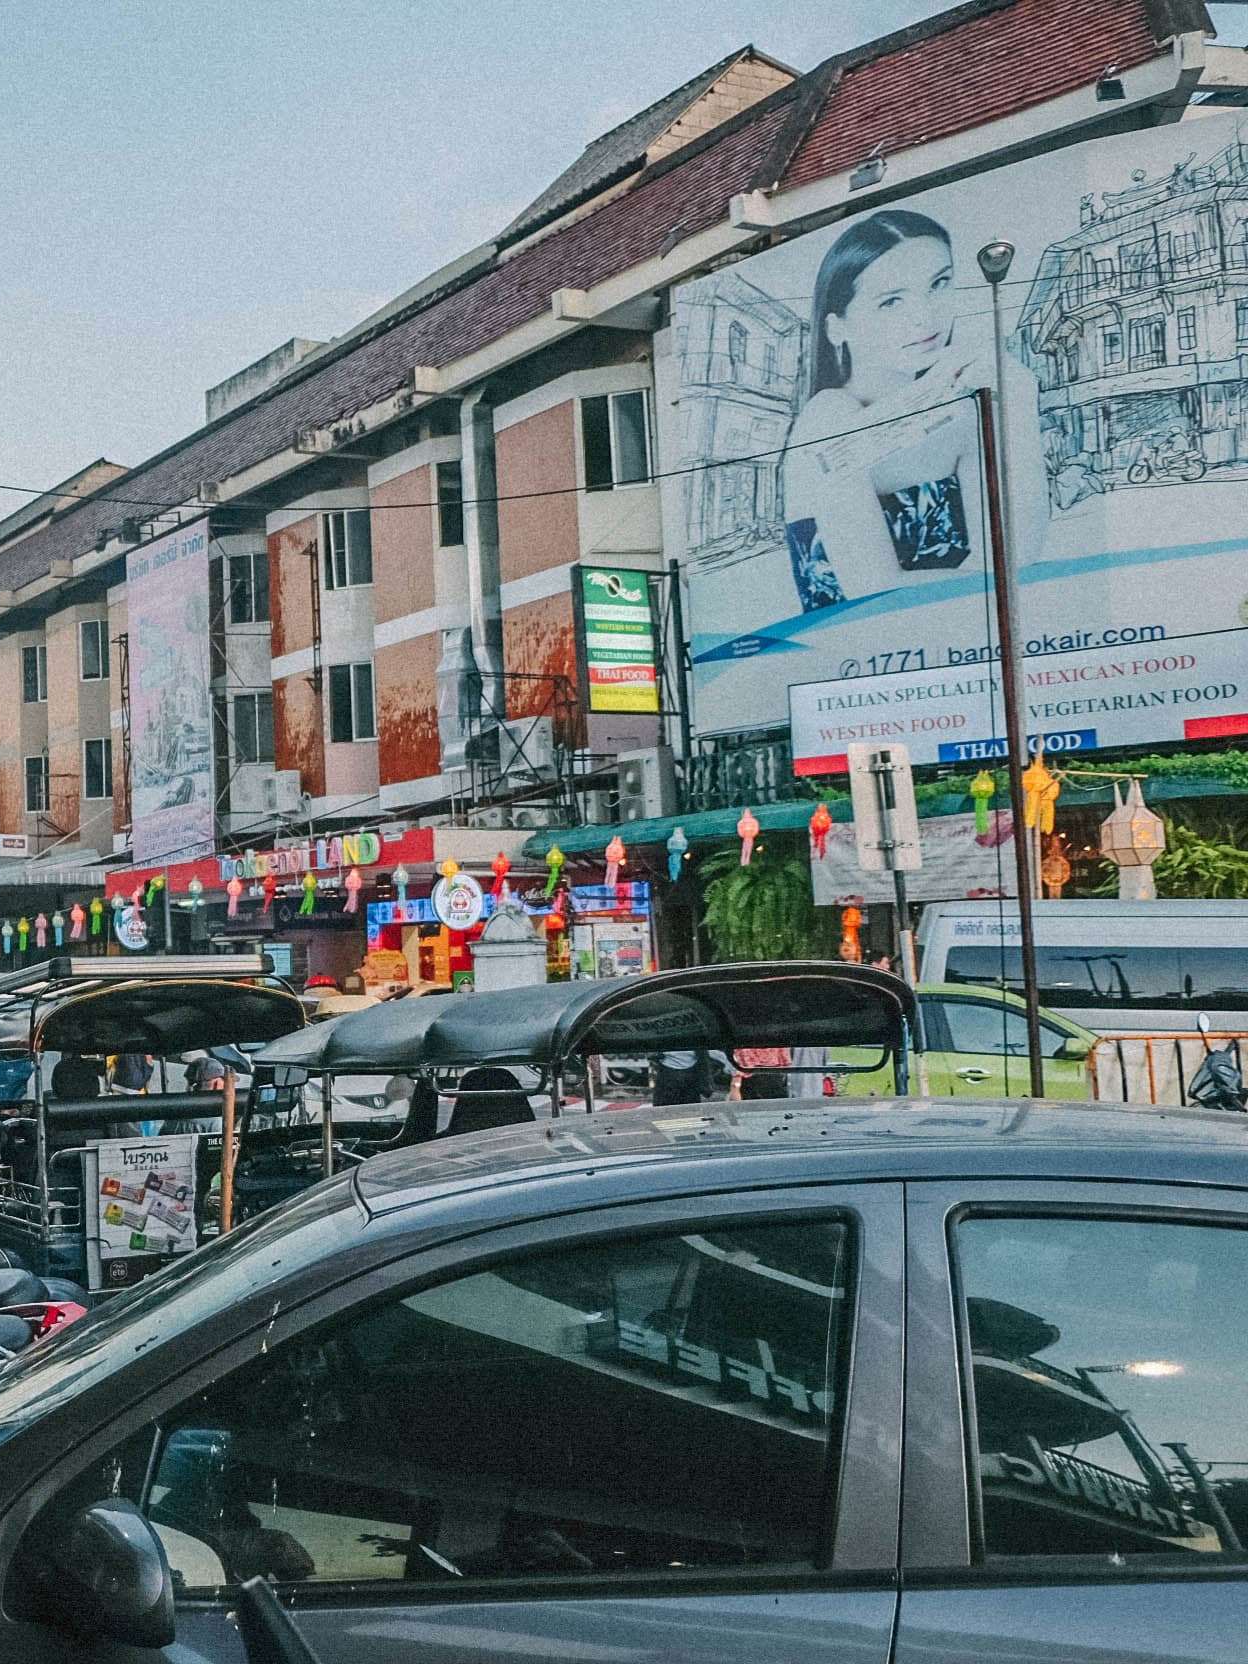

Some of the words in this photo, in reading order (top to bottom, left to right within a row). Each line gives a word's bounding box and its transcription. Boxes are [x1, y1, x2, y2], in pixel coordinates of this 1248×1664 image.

[867, 648, 926, 675] 1771
[948, 623, 1167, 666] banokair.com
[596, 669, 621, 680] THAI
[621, 669, 650, 680] FOOD
[1027, 662, 1126, 688] MEXICAN
[1132, 654, 1197, 676] FOOD
[817, 690, 890, 713] ITALIAN
[1029, 690, 1170, 719] VEGETARIAN
[1172, 683, 1239, 705] FOOD
[818, 720, 905, 744] WESTERN
[911, 713, 966, 733] FOOD
[955, 740, 1010, 761] THAI
[1027, 733, 1082, 752] OOD
[316, 832, 380, 870] LAND
[119, 1144, 170, 1166] โบราณ
